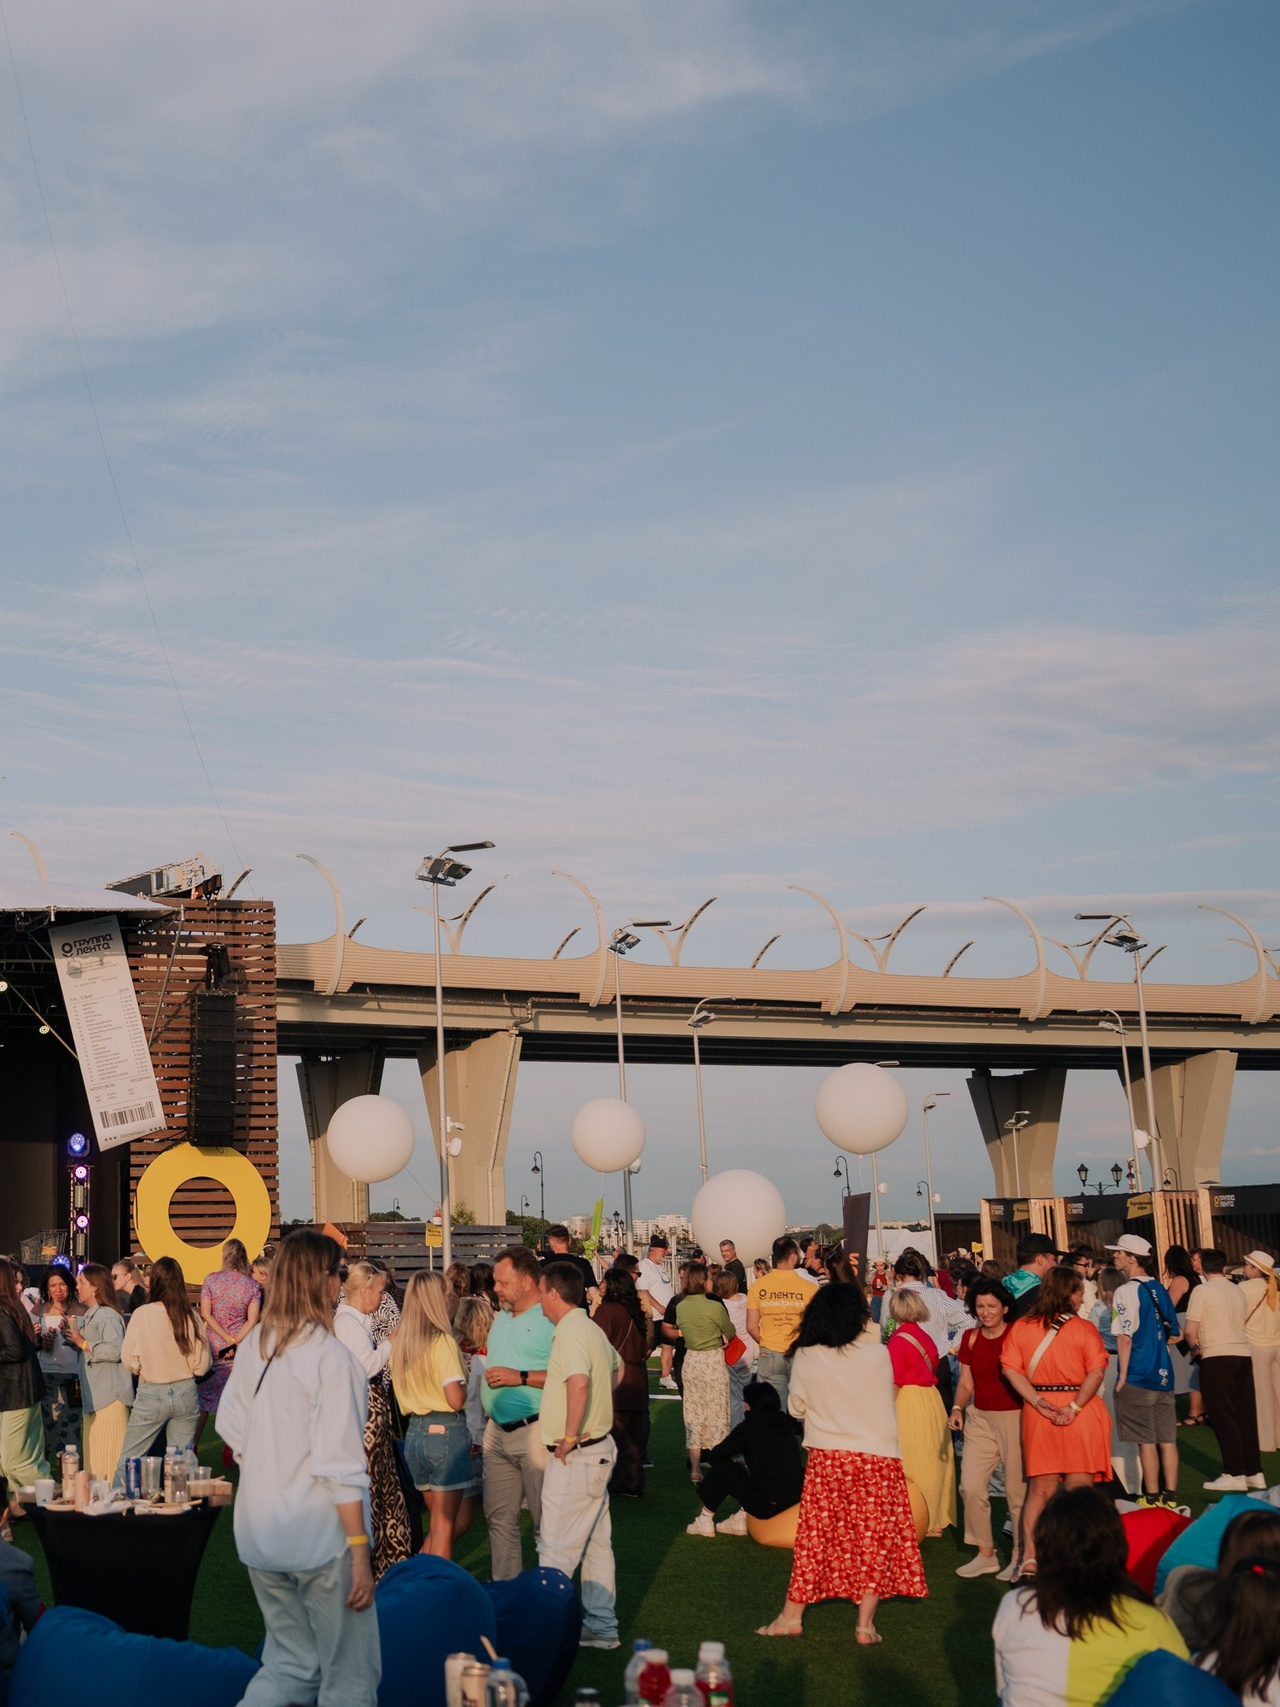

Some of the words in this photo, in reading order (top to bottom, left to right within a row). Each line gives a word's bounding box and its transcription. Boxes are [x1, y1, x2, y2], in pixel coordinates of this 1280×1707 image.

[73, 933, 113, 948] группа
[76, 942, 111, 956] лента
[769, 1291, 804, 1300] лента
